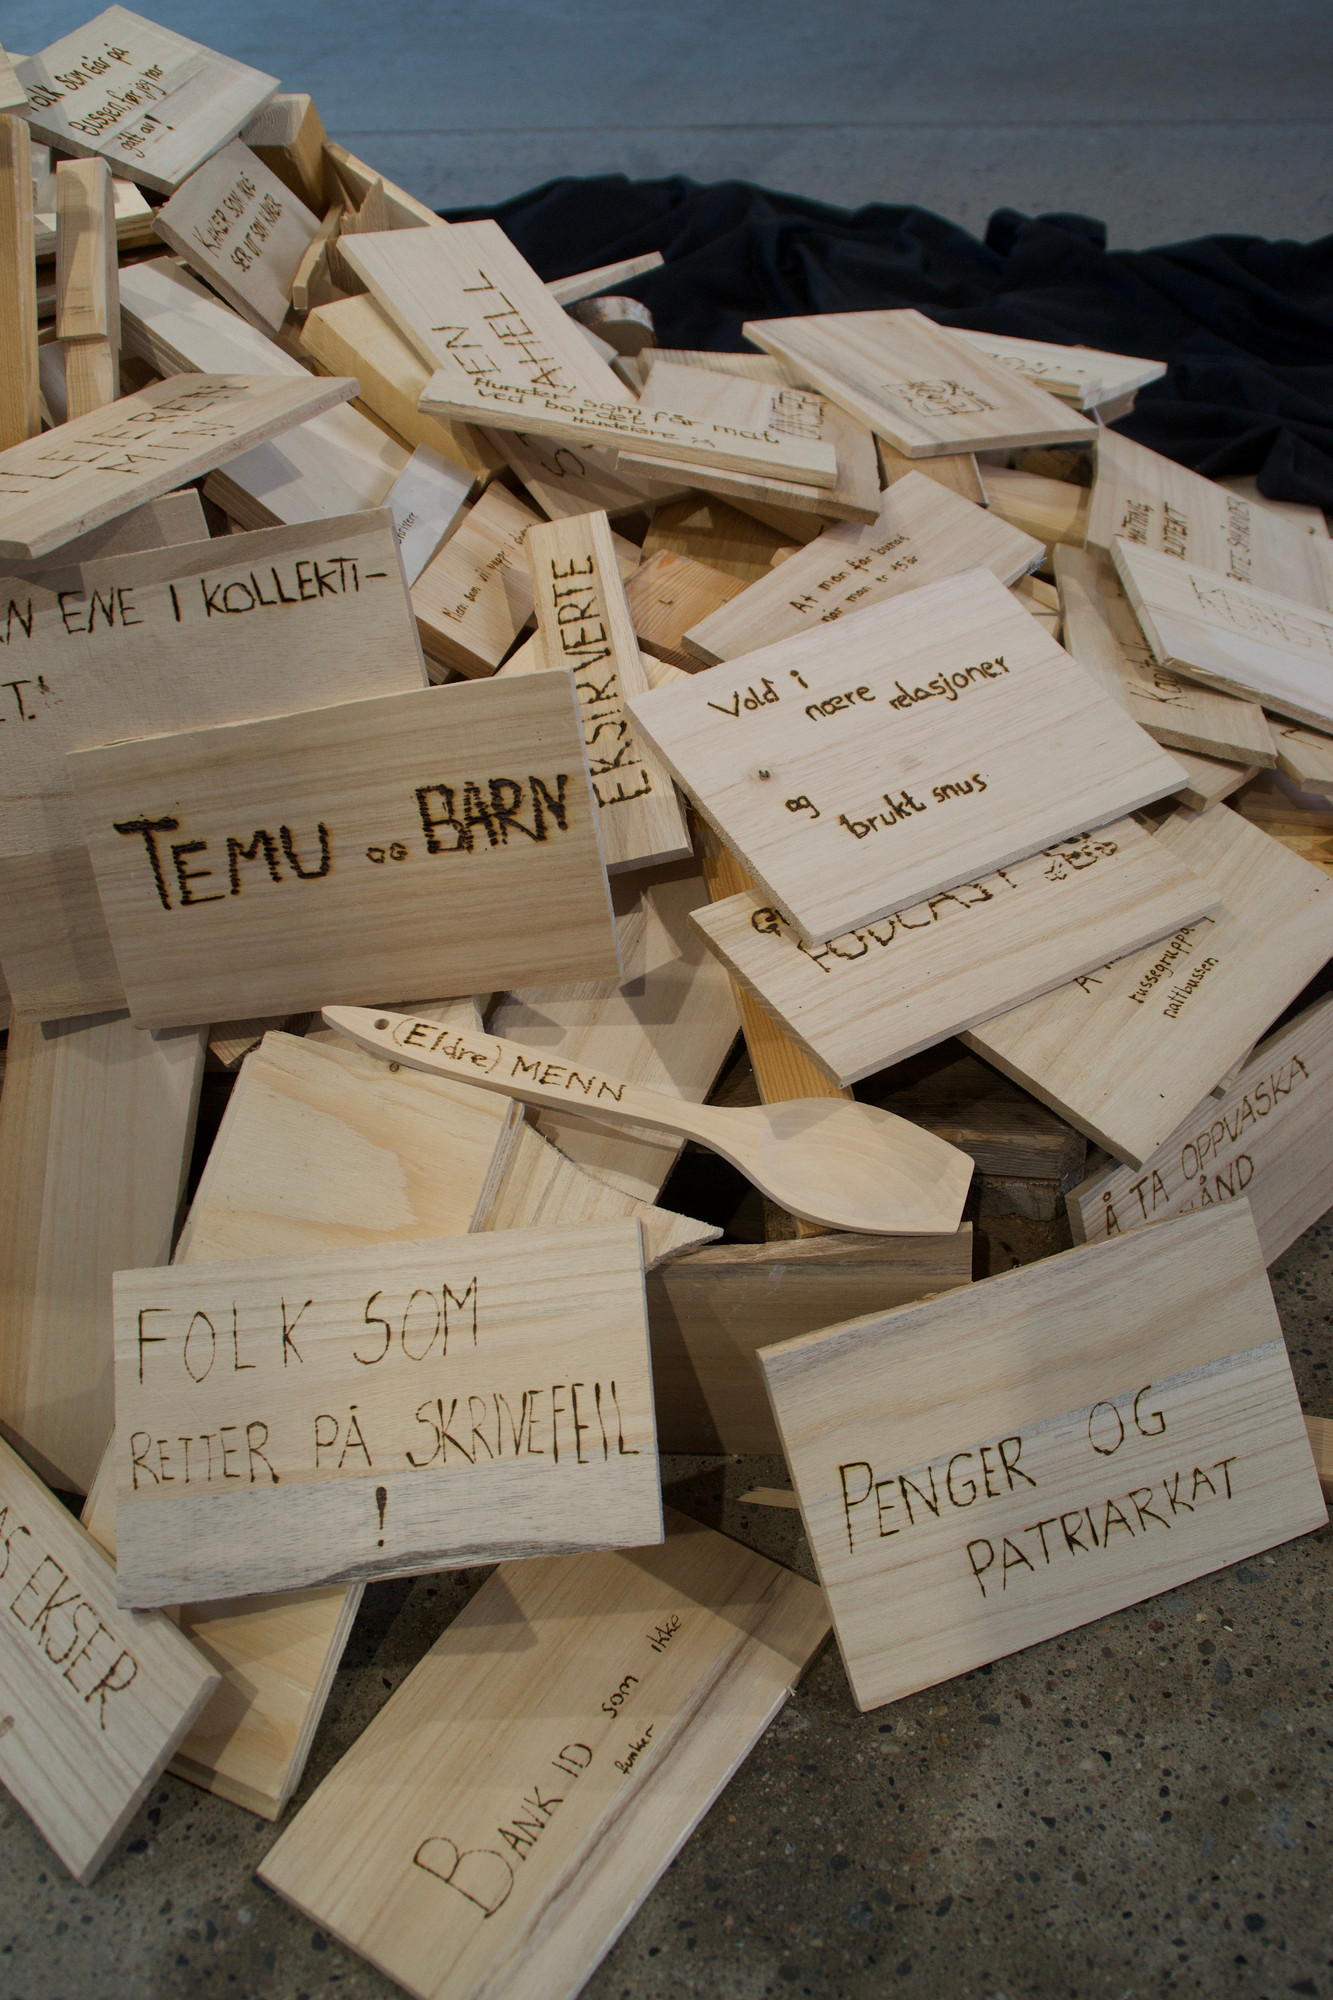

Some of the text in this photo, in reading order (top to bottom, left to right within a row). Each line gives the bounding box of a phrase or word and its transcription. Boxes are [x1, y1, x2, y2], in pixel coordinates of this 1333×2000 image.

[103, 42, 132, 66] på
[117, 131, 146, 158] gått
[192, 208, 235, 259] KAKER
[223, 189, 248, 218] SOM
[230, 246, 253, 272] SER
[243, 232, 263, 257] UT
[473, 377, 571, 400] Hunder
[583, 399, 642, 418] som
[652, 410, 704, 426] får
[477, 388, 646, 426] ved bordet
[58, 585, 144, 635] ENE
[169, 583, 181, 623] I
[789, 593, 820, 614] At
[817, 569, 850, 592] man
[845, 553, 873, 573] får
[845, 583, 872, 604] man
[876, 573, 889, 584] er
[707, 656, 1010, 722] Vold i nære relasjoner
[784, 772, 988, 840] og brukt snus
[113, 817, 330, 910] TEMU
[413, 773, 569, 855] BARN
[1128, 927, 1196, 1004] russegruppa
[1163, 956, 1219, 1019] nattbussen
[392, 1016, 627, 1102] (Eldre) MENN
[1102, 1054, 1310, 1236] Å TA OPPVASKA
[1179, 1154, 1256, 1214] ÅND
[137, 1274, 478, 1385] FOLK SOM
[130, 1380, 640, 1490] RETTER PÅ SKRIVEFEIL
[838, 1385, 1167, 1555] PENGER OG
[375, 1486, 388, 1548] !
[965, 1455, 1239, 1598] PATRIARKAT
[9, 1554, 138, 1731] EKSER
[551, 1742, 593, 1779] ID
[601, 1674, 639, 1719] som
[614, 1723, 654, 1775] funker
